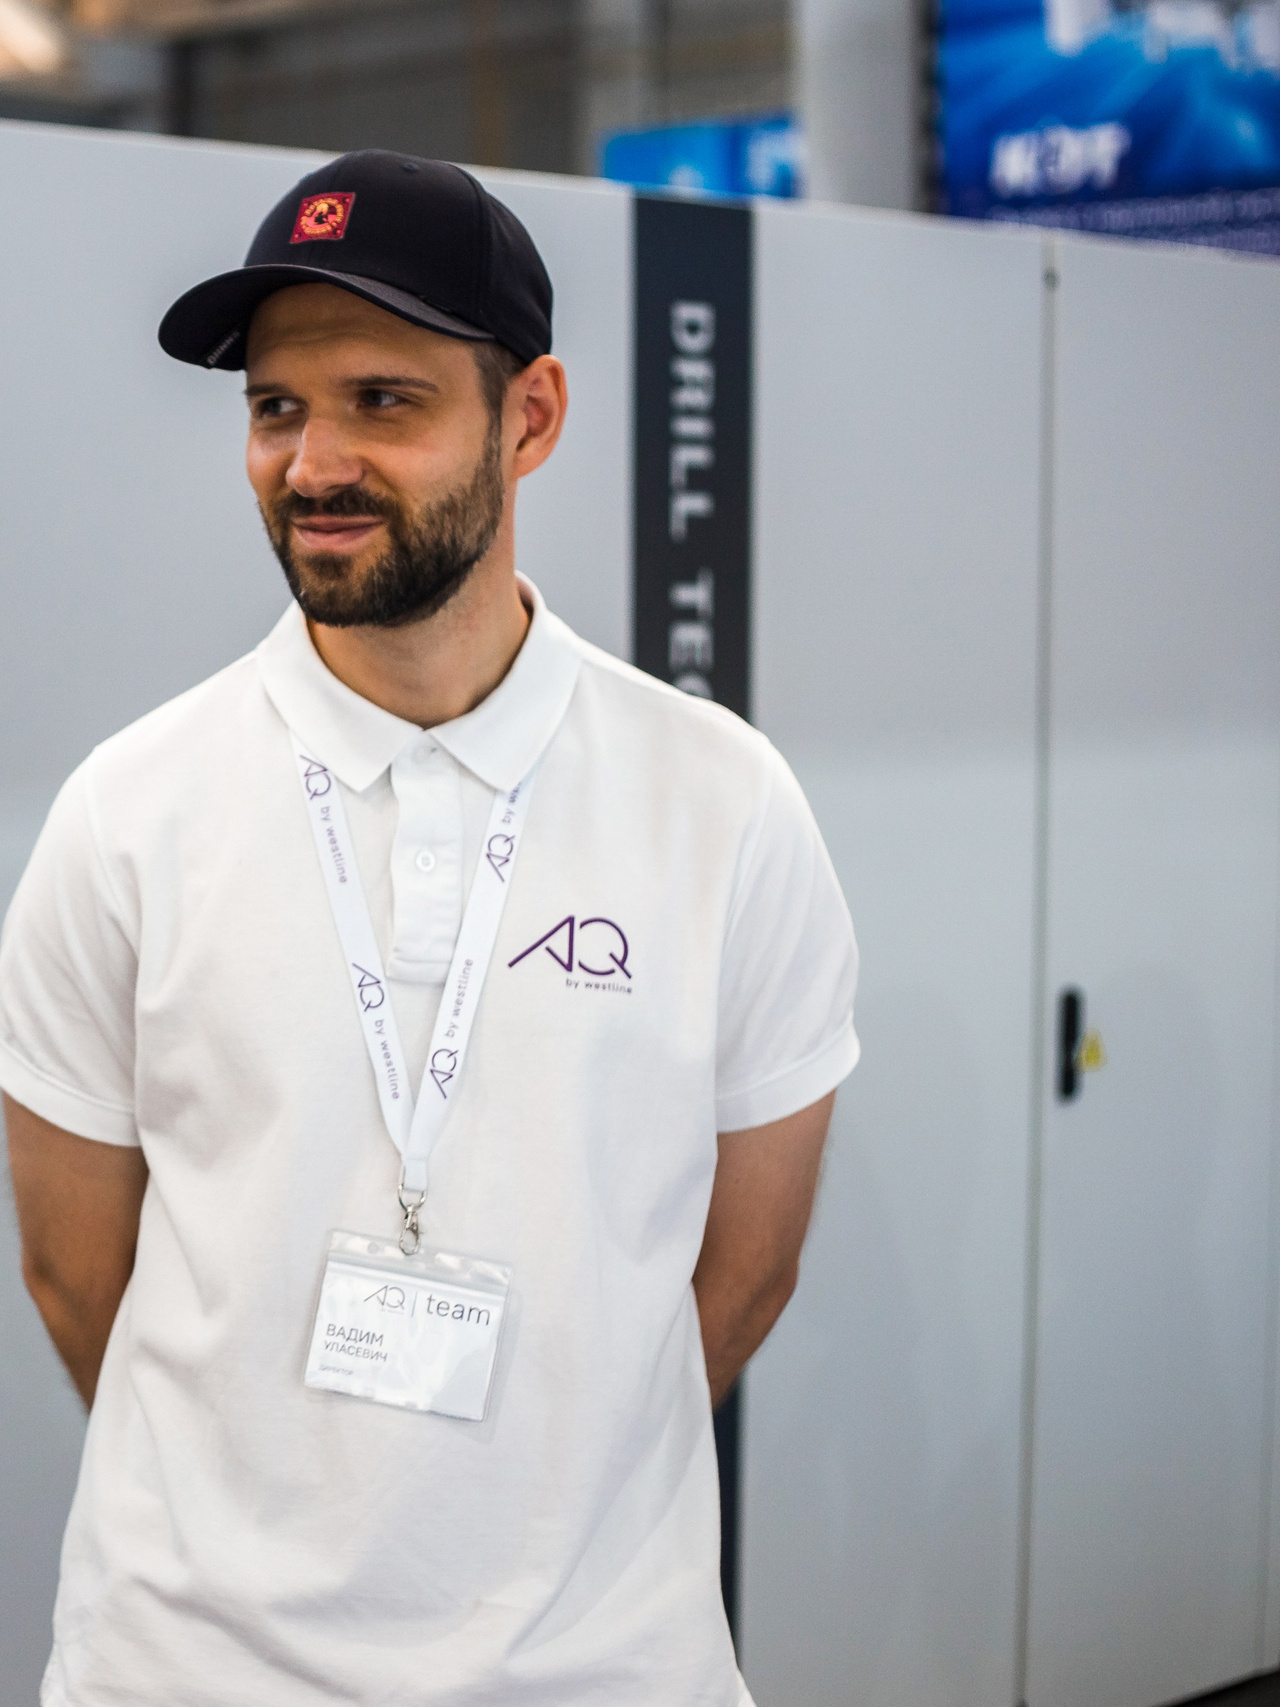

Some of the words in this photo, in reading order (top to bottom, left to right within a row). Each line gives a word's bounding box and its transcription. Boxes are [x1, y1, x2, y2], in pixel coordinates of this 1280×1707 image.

[669, 300, 716, 542] DRILL
[326, 825, 348, 884] westline
[507, 915, 632, 979] AQ
[452, 958, 474, 1017] westline
[380, 1040, 400, 1100] westline
[326, 1323, 384, 1347] ВАДИМ
[426, 1294, 490, 1326] team
